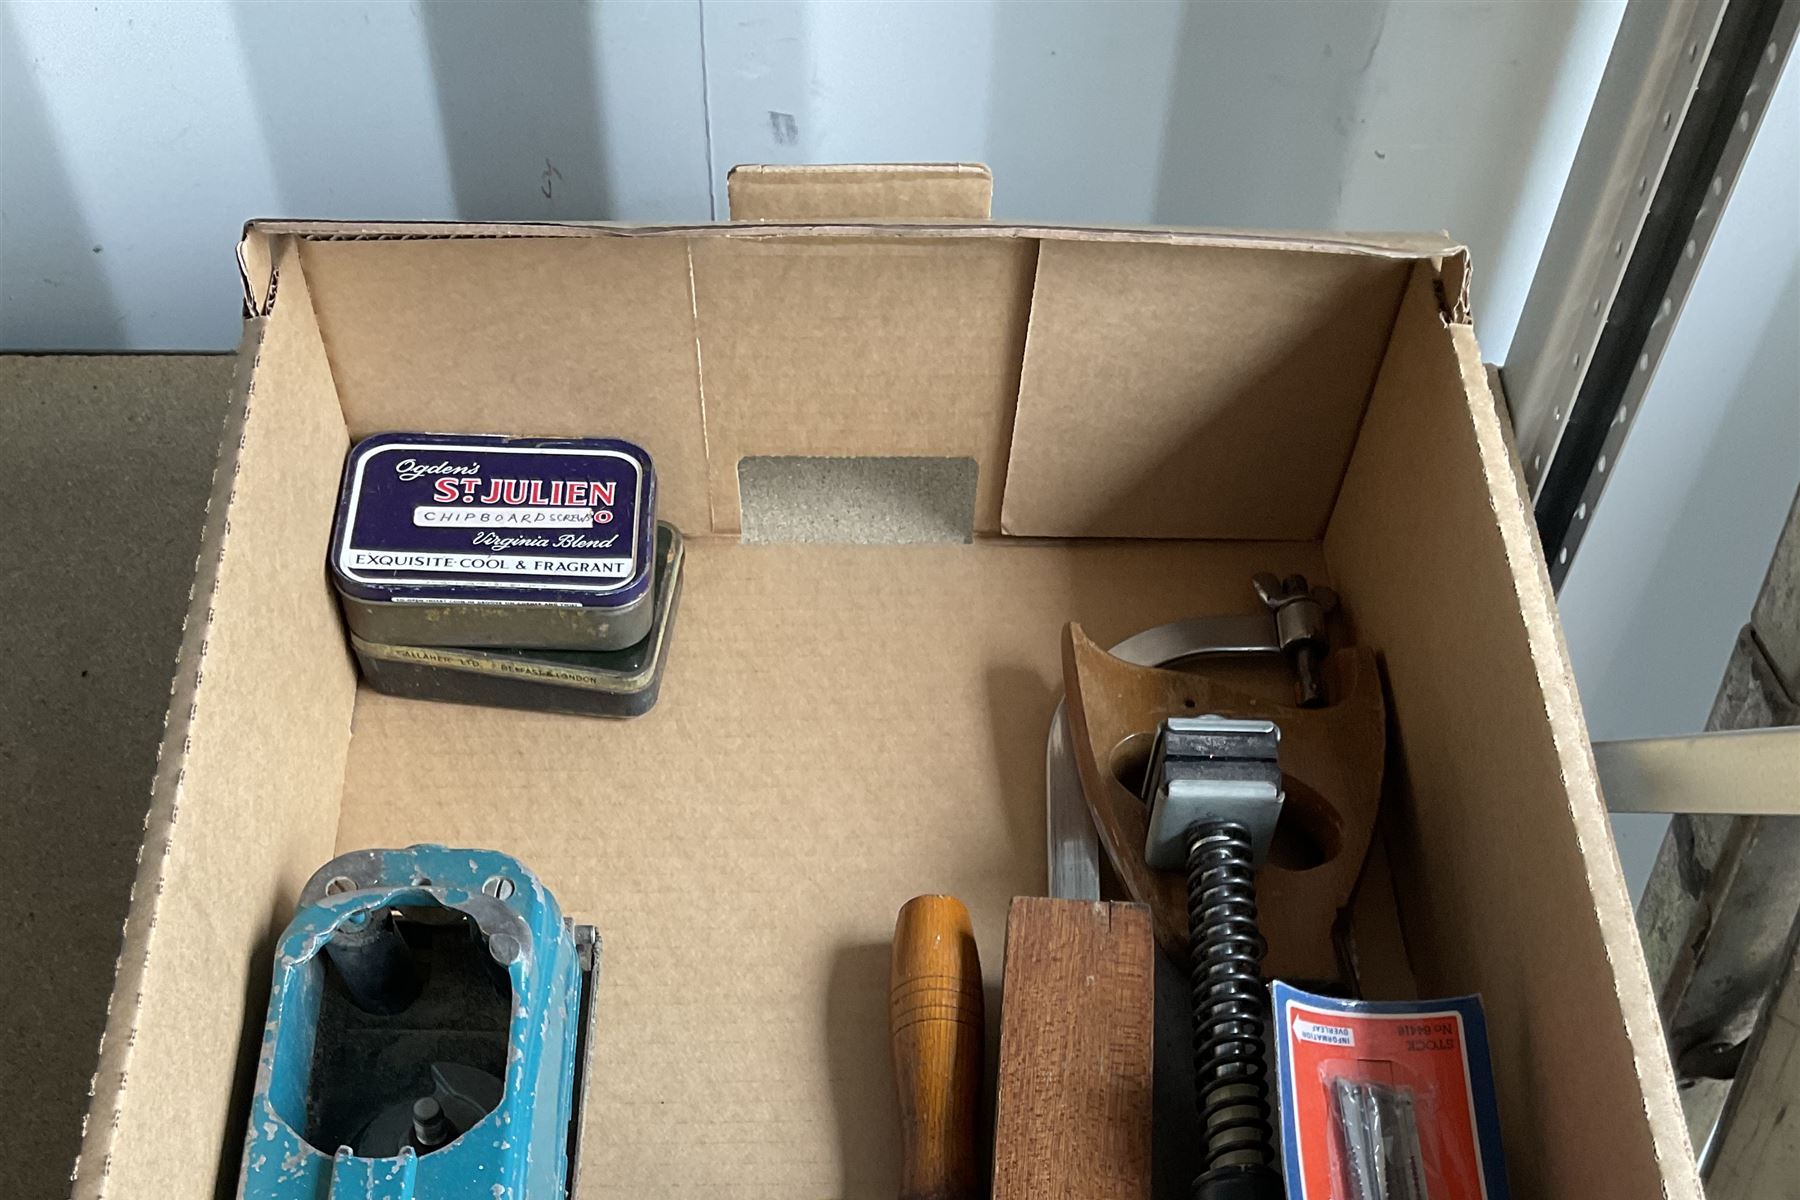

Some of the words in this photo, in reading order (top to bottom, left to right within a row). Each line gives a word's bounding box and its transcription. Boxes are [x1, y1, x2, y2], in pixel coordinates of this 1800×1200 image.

[395, 458, 480, 481] Ogden's
[480, 478, 617, 507] JULIEN
[423, 511, 546, 523] CHIPBOARD
[472, 531, 550, 551] Virginia
[552, 534, 619, 549] Blend
[515, 560, 527, 570] &
[534, 561, 625, 573] FRAGRANT
[1312, 1025, 1349, 1036] OVERLEAF
[1301, 1031, 1350, 1045] INFORMATION
